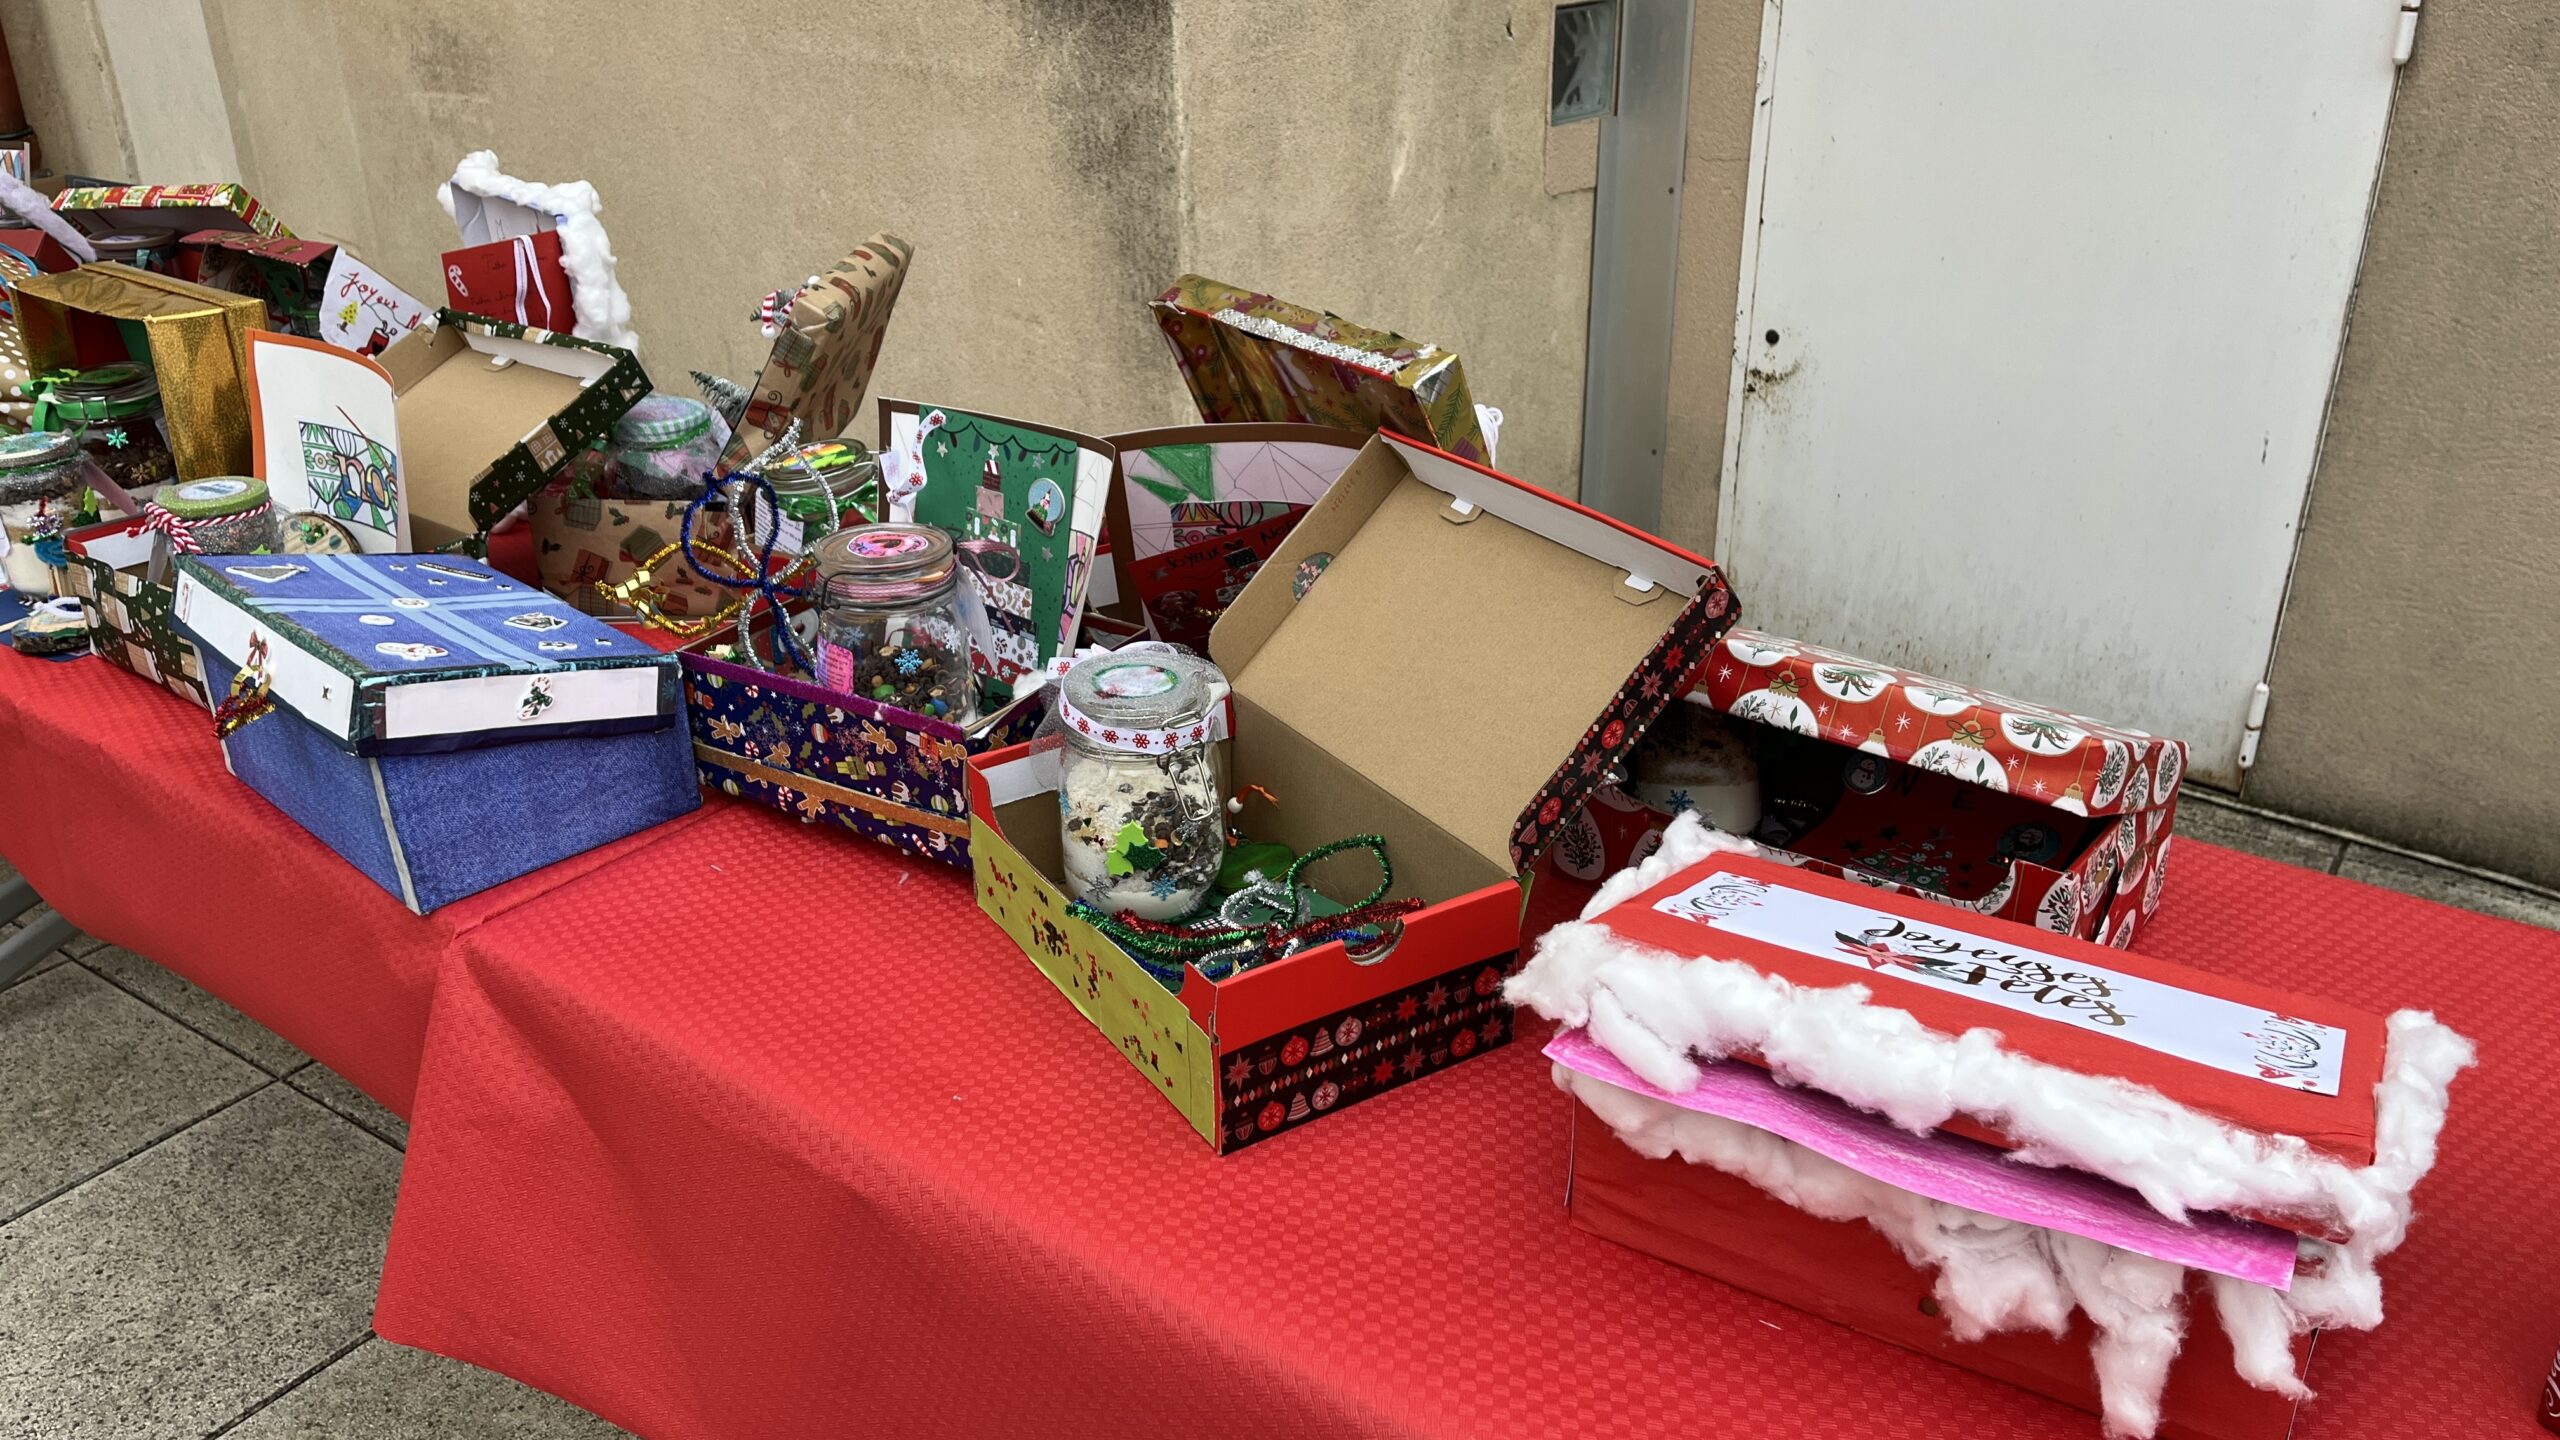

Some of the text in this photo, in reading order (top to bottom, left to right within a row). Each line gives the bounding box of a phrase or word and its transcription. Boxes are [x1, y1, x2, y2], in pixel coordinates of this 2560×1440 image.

[340, 272, 399, 309] Joyeux
[1863, 916, 2123, 998] Joyeuses
[1959, 961, 2138, 1026] Fêtes
